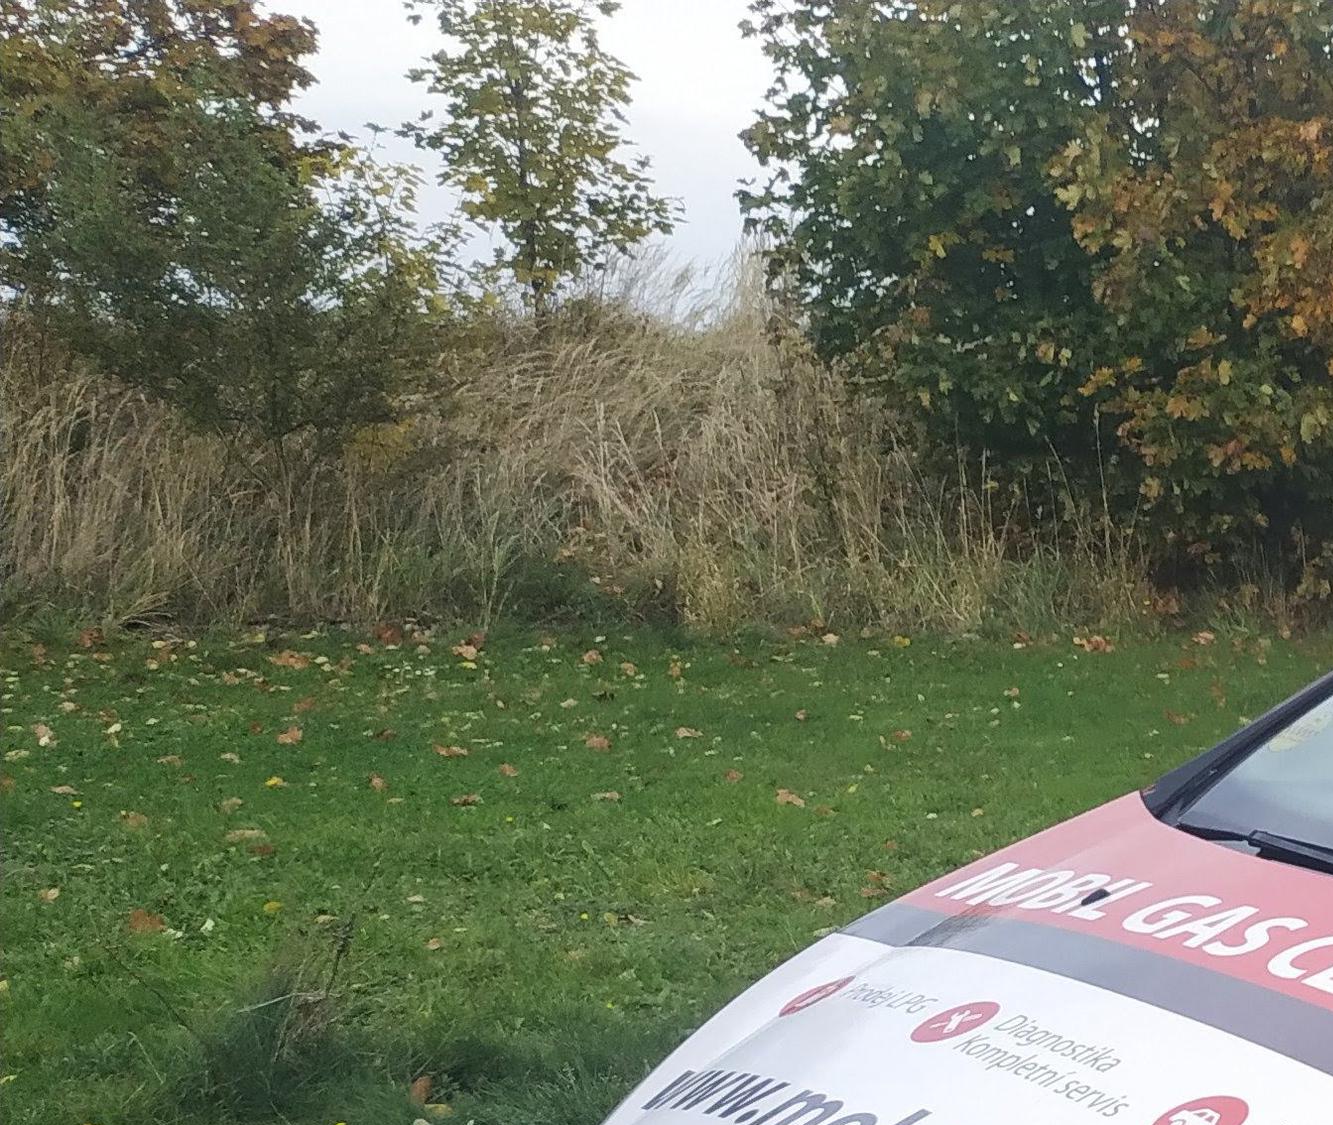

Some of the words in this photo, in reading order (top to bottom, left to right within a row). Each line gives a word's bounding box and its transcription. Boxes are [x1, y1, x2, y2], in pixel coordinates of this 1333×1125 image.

[934, 861, 1153, 921] MOBIL
[1122, 894, 1310, 957] GAS
[887, 990, 939, 1014] LPG
[952, 1033, 1077, 1089] Kompletní
[1052, 1078, 1130, 1118] servis
[993, 1014, 1122, 1073] Diagnostika
